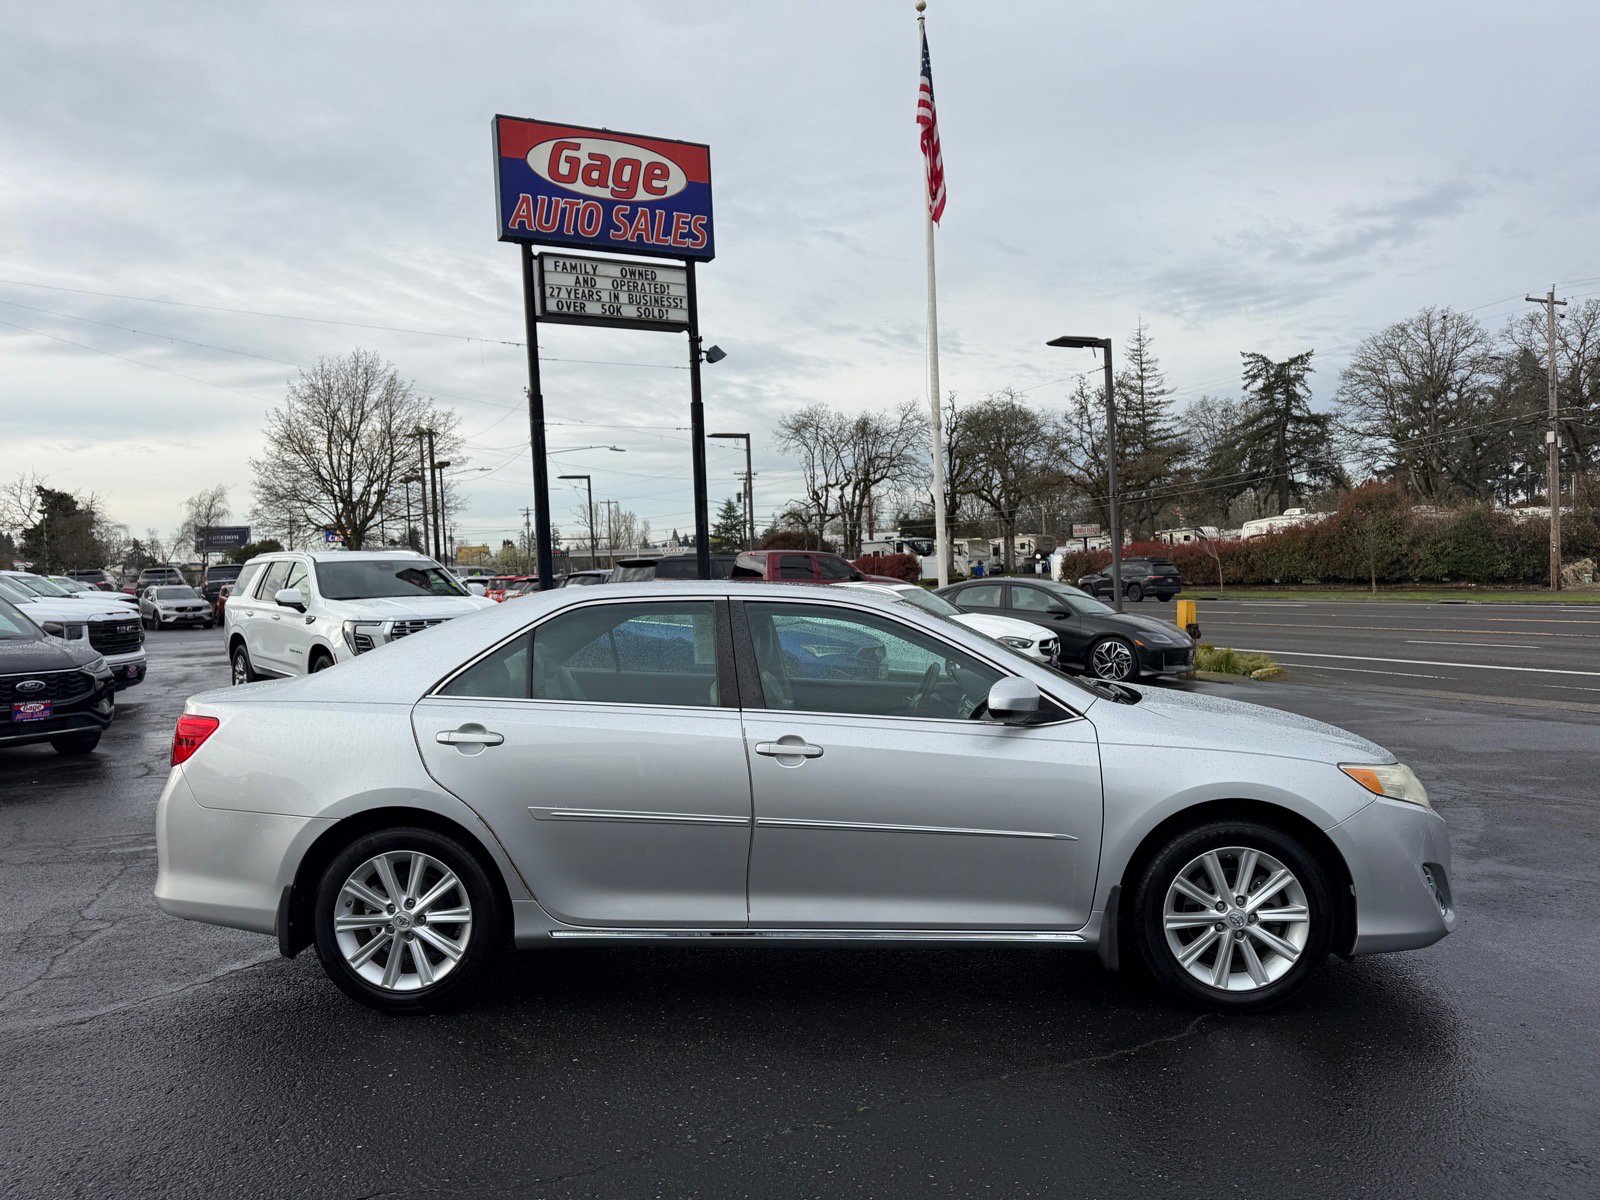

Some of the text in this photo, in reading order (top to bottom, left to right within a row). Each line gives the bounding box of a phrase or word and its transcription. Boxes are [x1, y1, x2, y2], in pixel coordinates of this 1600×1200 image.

[548, 140, 670, 199] Gage
[508, 193, 708, 249] AUTO SALES
[554, 260, 657, 281] FAMILY OWNED
[574, 275, 670, 295] AND OPERATED!
[549, 286, 683, 309] 27 YEARS IN BUSINESS!
[556, 300, 669, 320] OVER 50K SOLD!
